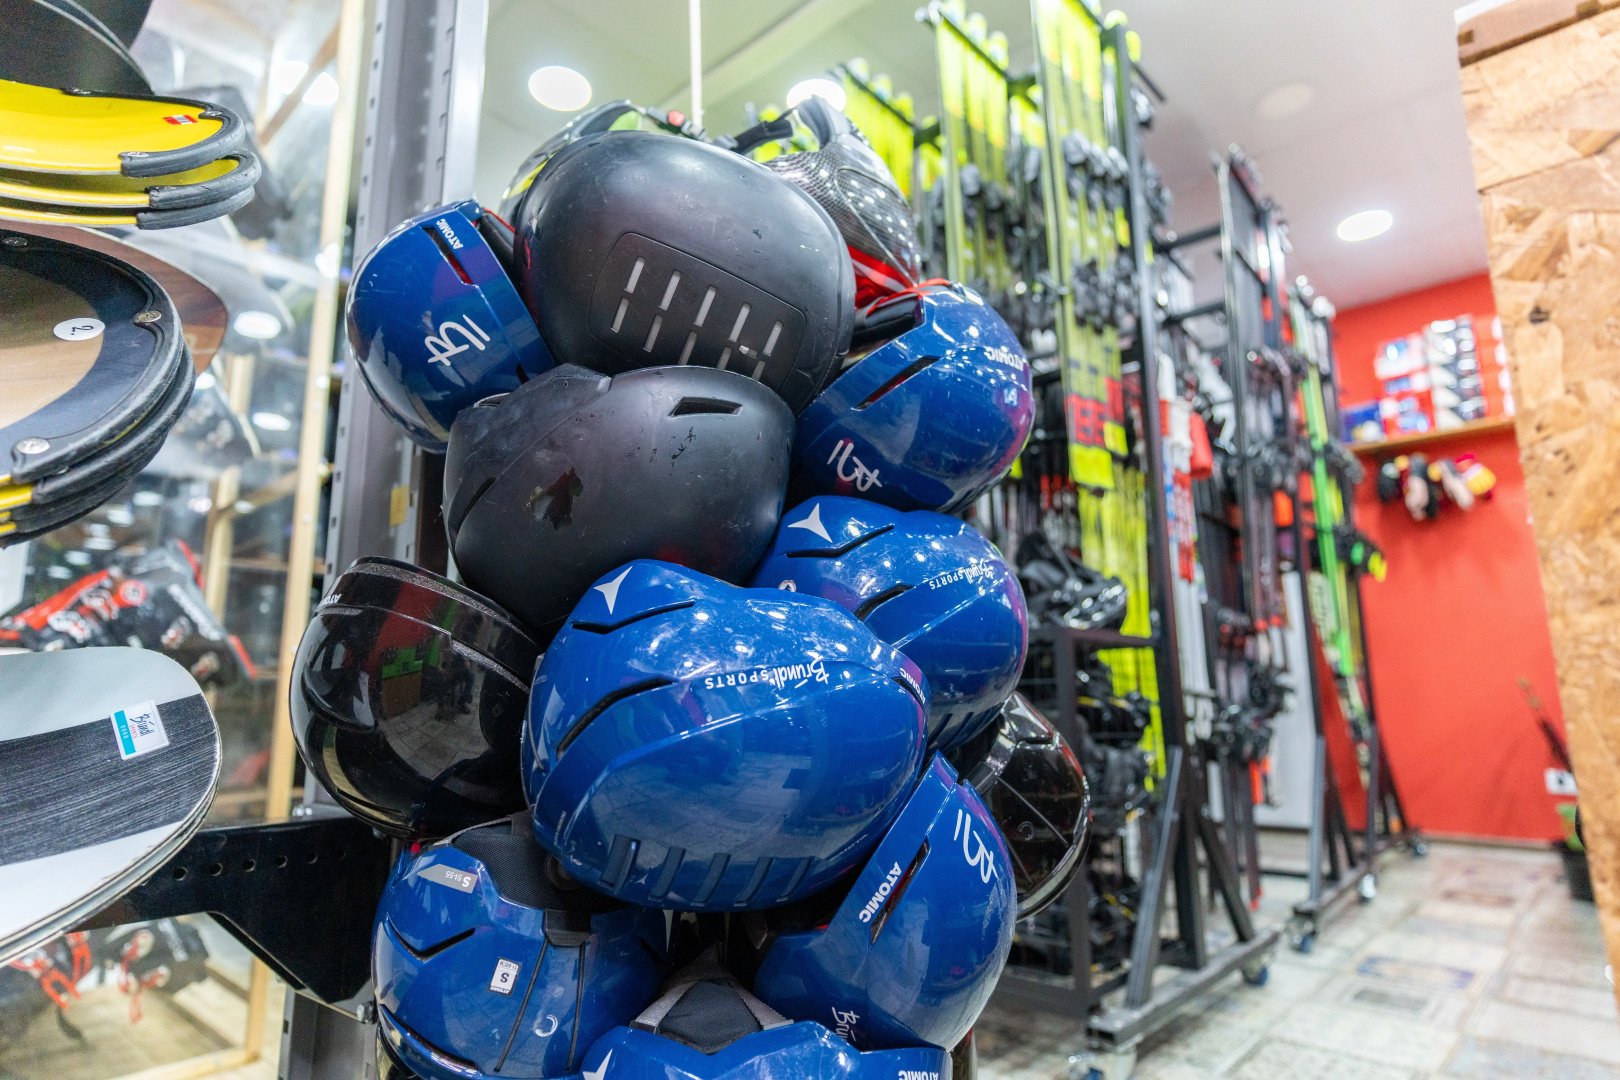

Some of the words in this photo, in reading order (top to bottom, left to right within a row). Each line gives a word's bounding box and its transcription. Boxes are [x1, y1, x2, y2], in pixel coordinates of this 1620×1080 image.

[436, 218, 464, 250] ATOMIC
[983, 345, 1025, 372] ATOMIC
[929, 569, 964, 590] SPORTS
[704, 670, 769, 690] SPORTS
[899, 667, 926, 705] ATOMIC
[445, 870, 463, 882] 51-55
[461, 876, 472, 888] S
[859, 861, 902, 923] ATOMIC
[500, 972, 510, 983] S
